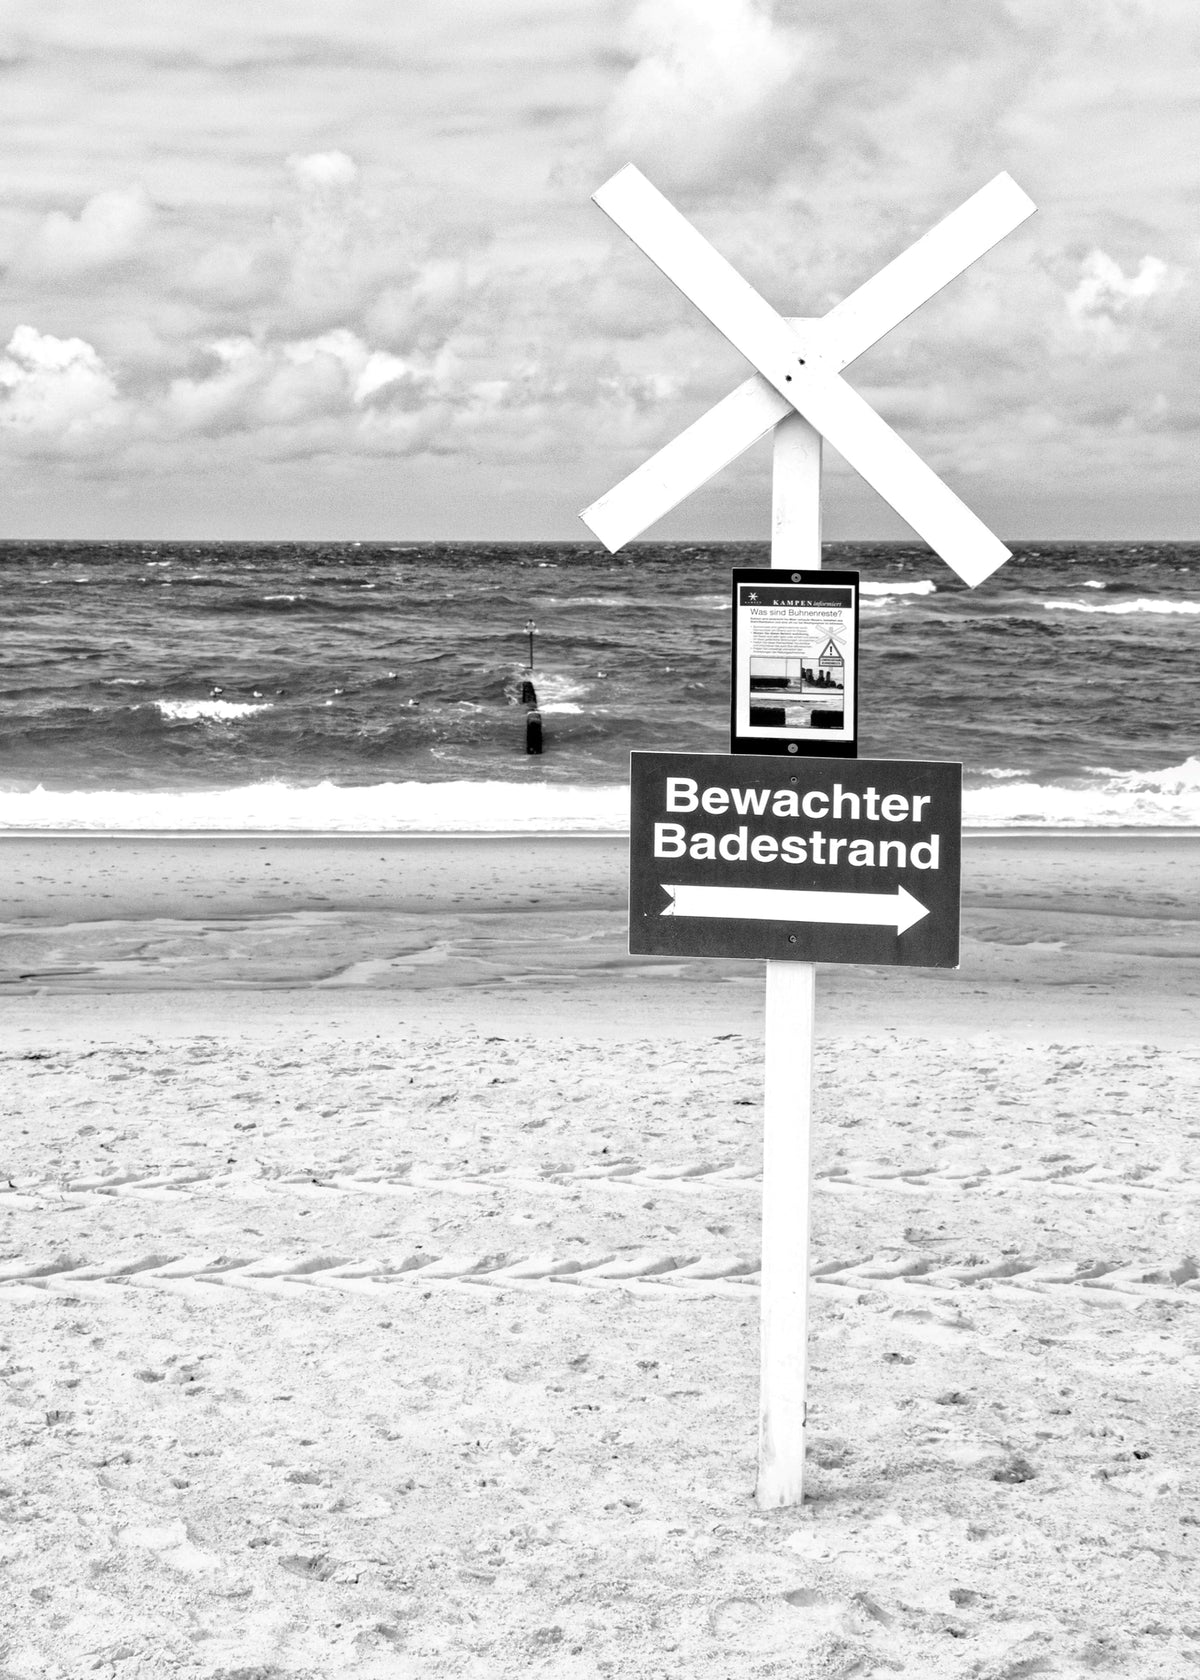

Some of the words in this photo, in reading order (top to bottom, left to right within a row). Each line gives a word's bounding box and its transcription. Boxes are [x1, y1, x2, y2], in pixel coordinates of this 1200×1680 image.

[788, 609, 843, 617] Buhnenreste?
[665, 777, 931, 822] Bewachter
[653, 823, 939, 870] Badestrand
